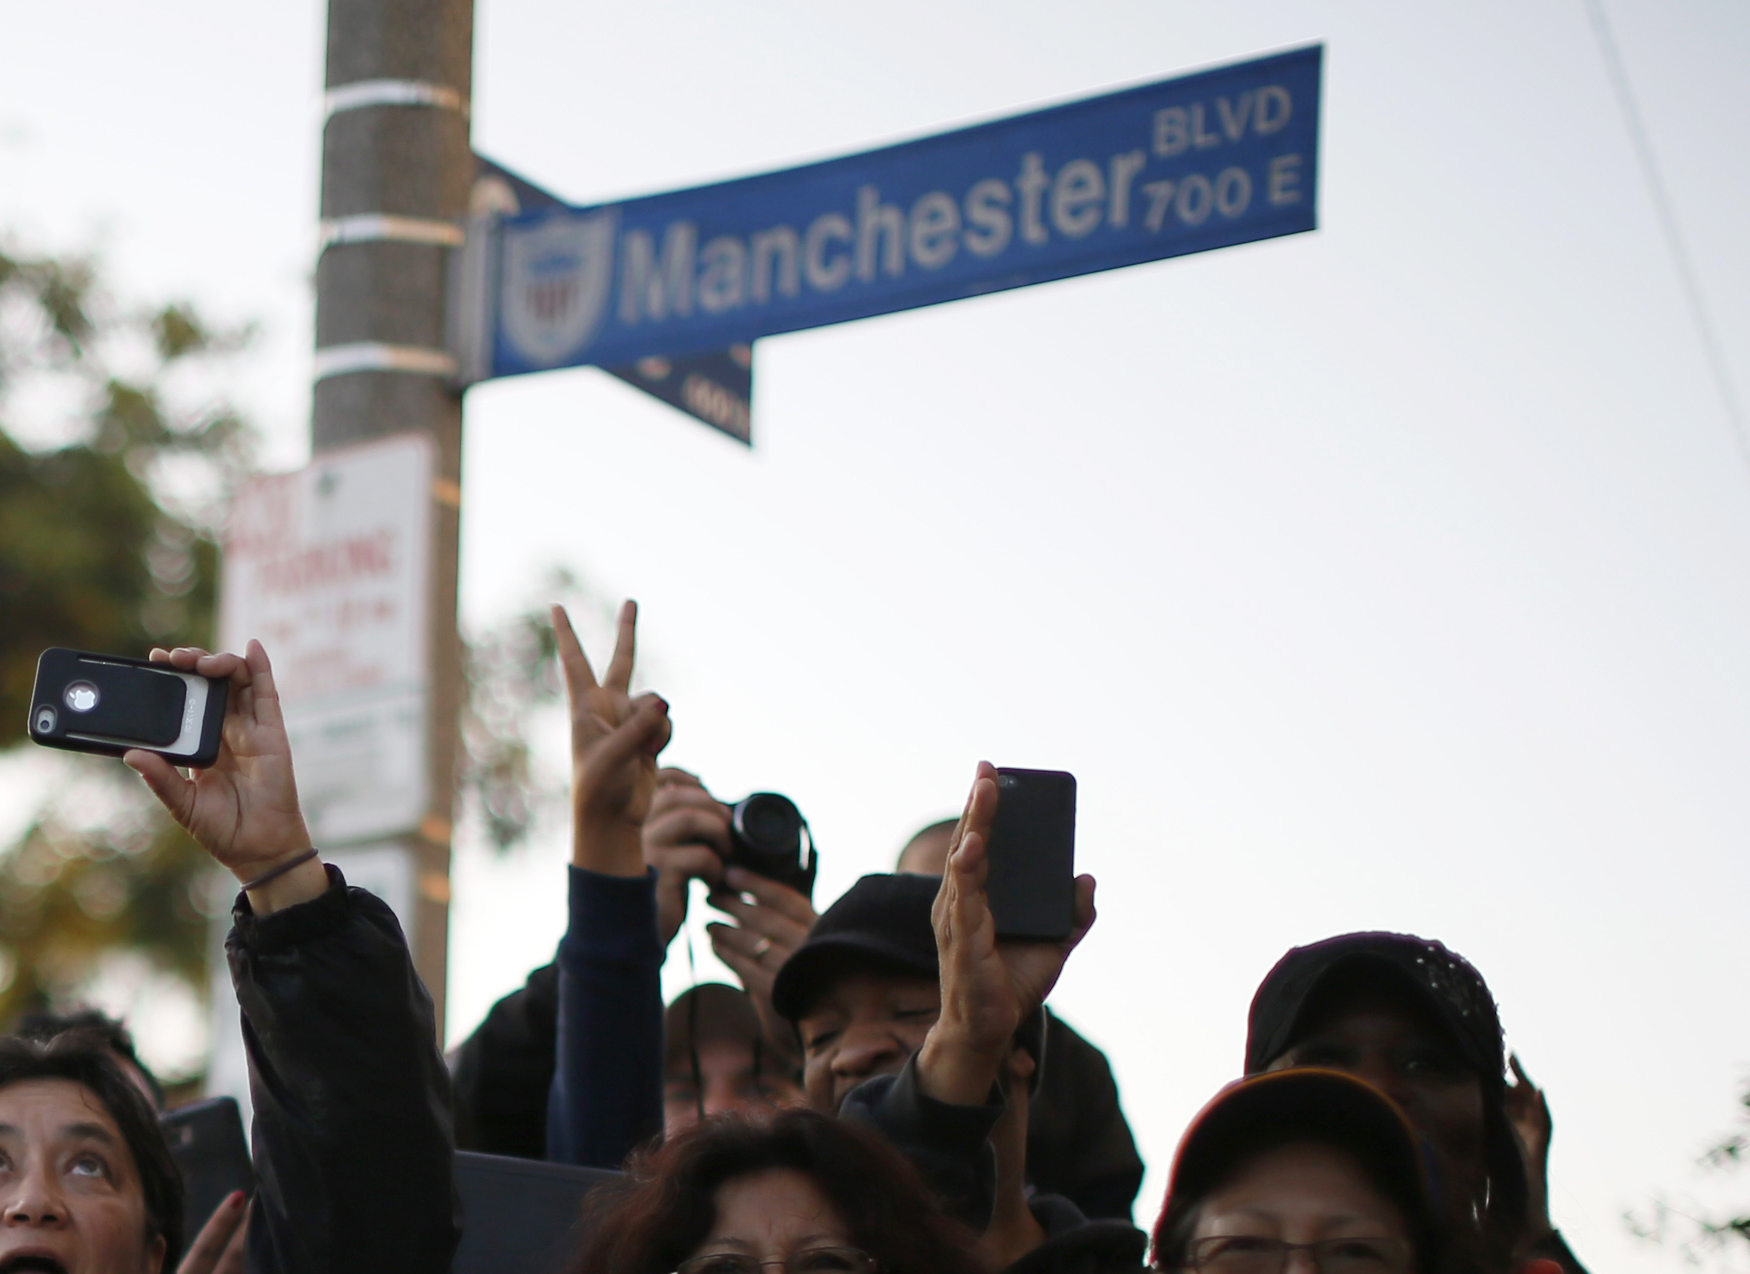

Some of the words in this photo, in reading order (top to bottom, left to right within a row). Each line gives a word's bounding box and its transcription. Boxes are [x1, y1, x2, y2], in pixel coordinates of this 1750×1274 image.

[1154, 87, 1291, 155] BLVD
[1143, 168, 1251, 231] 700
[1271, 157, 1302, 204] E
[616, 150, 1144, 326] Manchester
